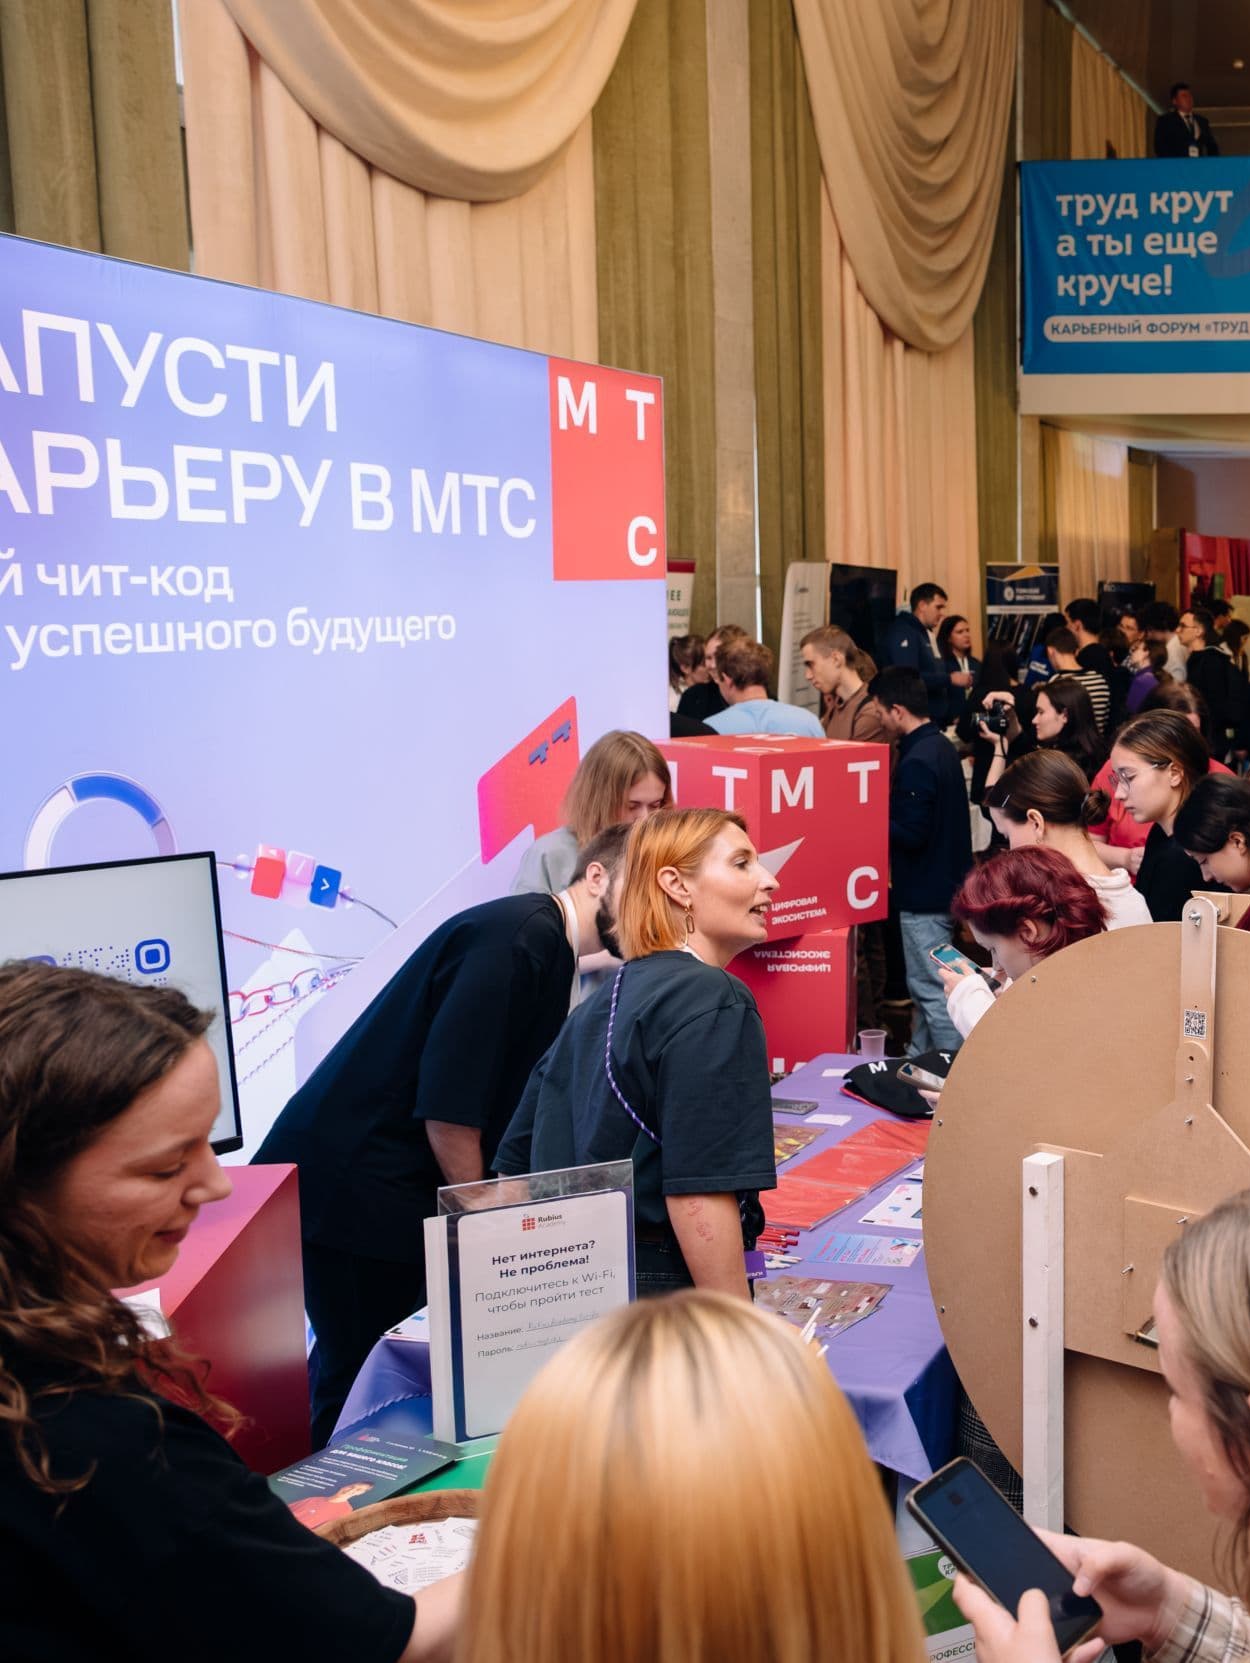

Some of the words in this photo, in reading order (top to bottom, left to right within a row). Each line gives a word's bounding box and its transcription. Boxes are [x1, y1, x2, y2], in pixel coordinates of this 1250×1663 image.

[1056, 192, 1139, 226] труд
[1150, 190, 1233, 225] крут
[1056, 234, 1077, 257] а
[1086, 233, 1133, 256] ты
[1143, 230, 1219, 258] еще
[1057, 263, 1173, 306] круче!
[1050, 319, 1142, 336] КАРЬЕРНЫЙ
[1146, 320, 1201, 335] ФОРУМ
[1205, 320, 1250, 335] «ТРУД
[0, 308, 337, 432] ПУСТИ
[349, 462, 395, 532] В
[411, 468, 537, 539] МТС
[36, 563, 235, 603] чит-код
[5, 618, 278, 671] успешного
[286, 606, 457, 656] будущего
[771, 896, 818, 912] ЦИФРОВАЯ
[771, 907, 828, 925] ЭКОСИСТЕМА
[754, 950, 832, 959] ЭКОСИСТЕМА
[767, 963, 832, 973] ЦИФРОВАЯ
[537, 1213, 563, 1223] Rubius
[492, 1253, 517, 1266] Нет
[519, 1240, 596, 1261] интернета?
[499, 1267, 518, 1279] Не
[521, 1254, 590, 1275] проблема!
[475, 1279, 569, 1302] Подключитесь
[572, 1276, 579, 1285] к
[581, 1268, 616, 1283] Wi-Fi,
[487, 1300, 526, 1314] чтобы
[530, 1291, 576, 1307] пройти
[579, 1286, 605, 1297] тест
[930, 1641, 976, 1662] РОФЕСС
